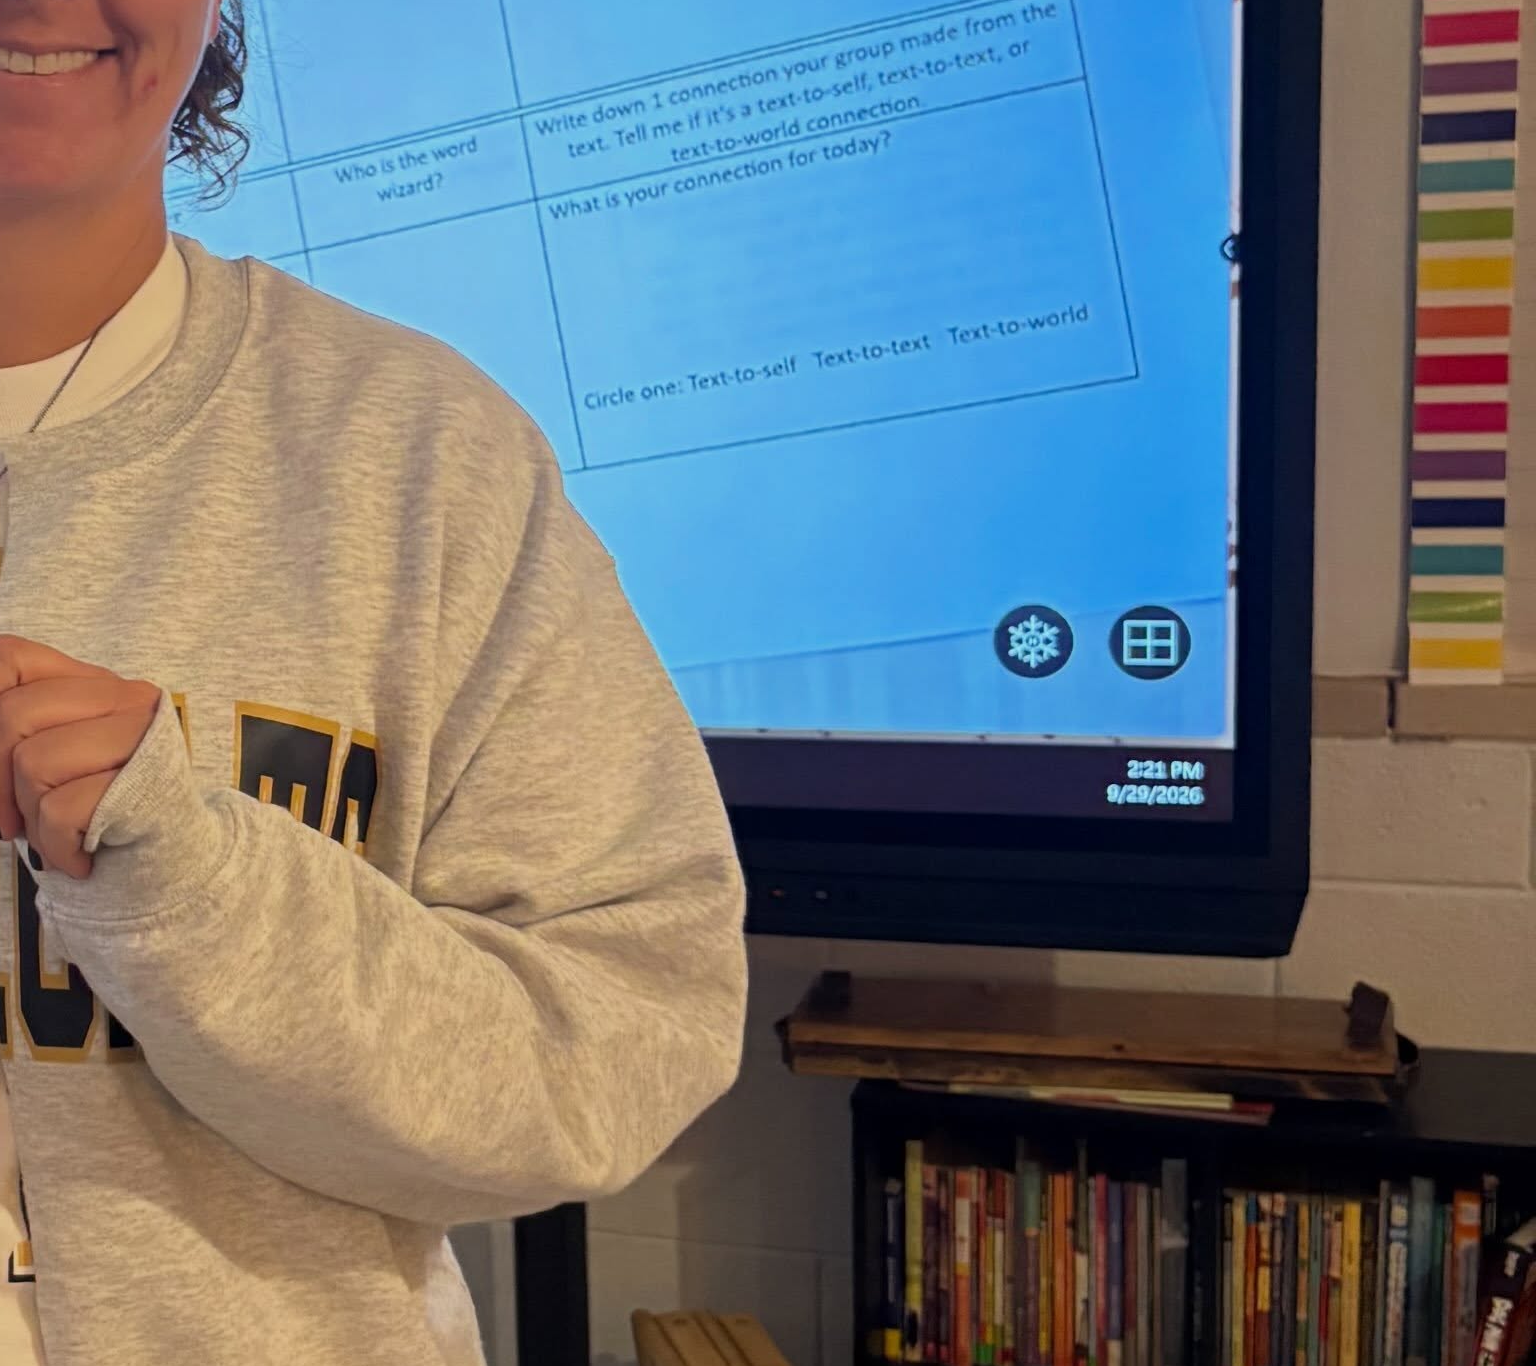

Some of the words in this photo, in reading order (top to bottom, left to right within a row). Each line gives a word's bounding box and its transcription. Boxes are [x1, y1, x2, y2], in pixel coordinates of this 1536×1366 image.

[534, 111, 588, 136] Write
[593, 99, 646, 124] down
[654, 92, 662, 109] 1
[668, 66, 778, 105] connection
[782, 55, 827, 81] your
[835, 40, 895, 68] group
[900, 23, 959, 53] made
[965, 12, 1016, 37] from
[1022, 2, 1057, 24] the
[614, 124, 647, 147] Tell
[652, 119, 683, 139] me
[689, 113, 700, 131] if
[707, 106, 737, 126] it's
[741, 104, 752, 118] a
[758, 72, 873, 113] text-to-self,
[878, 47, 1003, 87] text-to-text,
[1008, 39, 1030, 58] or
[334, 163, 376, 183] Who
[381, 158, 395, 174] is
[398, 150, 428, 171] the
[432, 135, 478, 162] word
[671, 119, 801, 164] text-to-world
[377, 171, 444, 202] wizard?
[549, 196, 601, 220] What
[606, 190, 620, 208] is
[624, 182, 669, 208] your
[673, 157, 784, 194] connection
[788, 148, 816, 169] for
[822, 130, 892, 161] today?
[584, 388, 635, 410] Circle
[640, 380, 683, 400] one:
[687, 355, 797, 392] Text-to-self
[812, 335, 932, 369] Text-to-text
[946, 303, 1089, 345] Text-to-world
[1127, 759, 1166, 780] 2:21
[1171, 760, 1204, 781] PM
[1106, 784, 1205, 805] 9/29/2026
